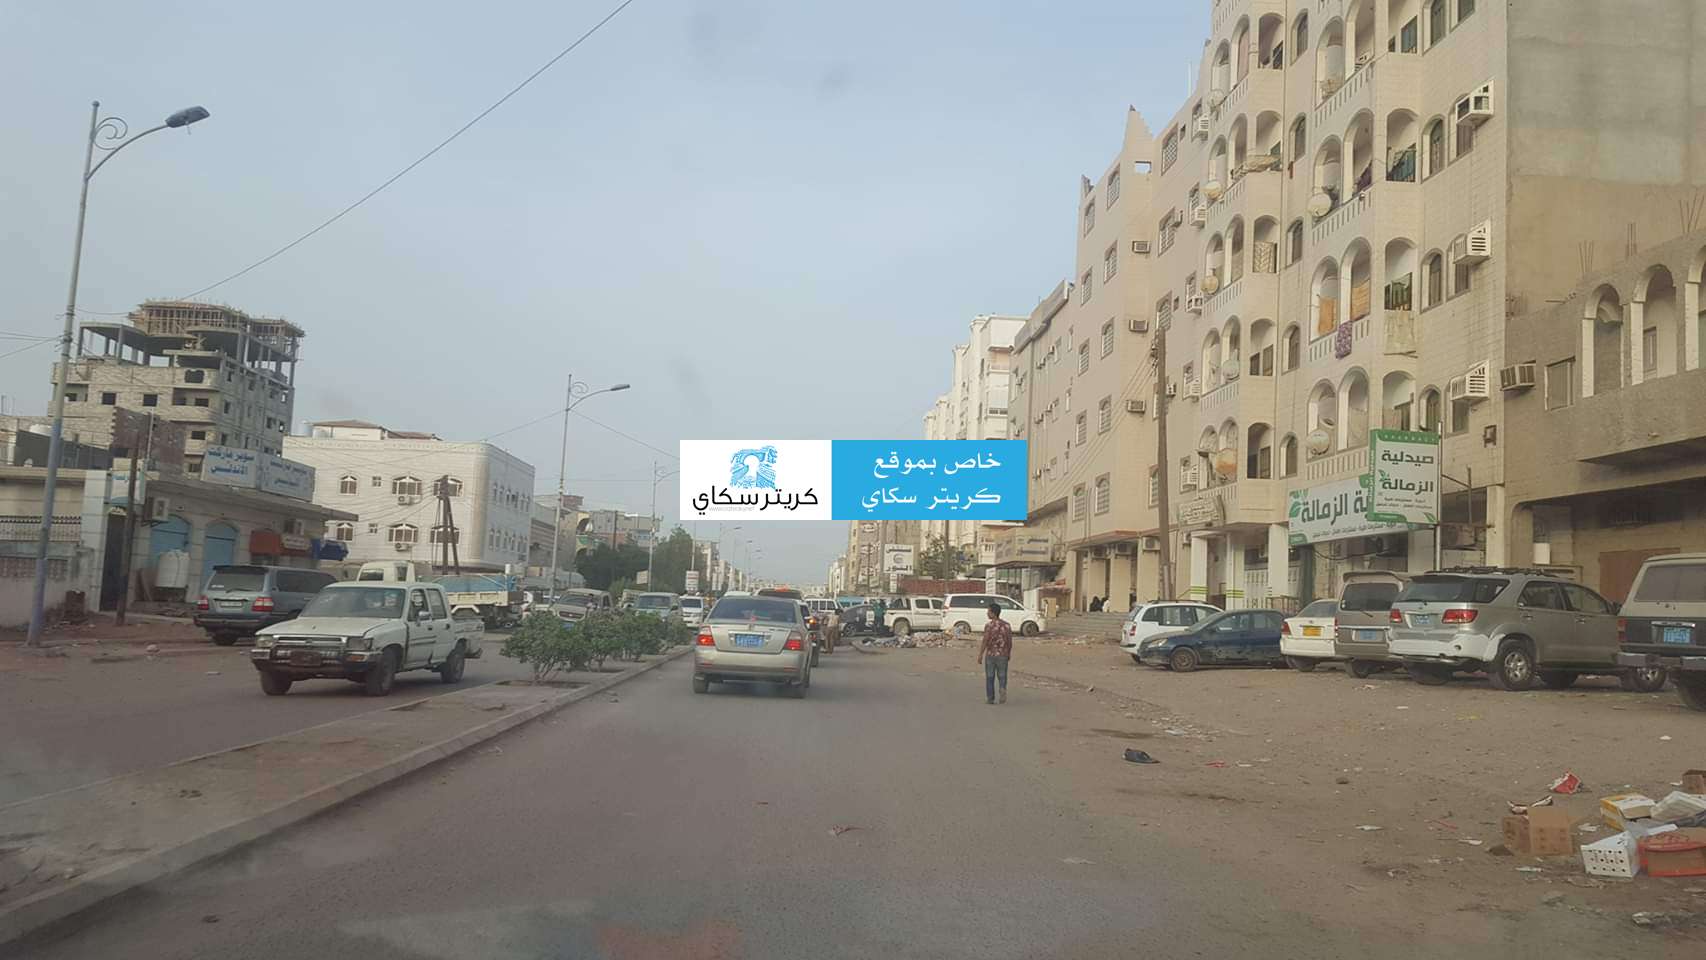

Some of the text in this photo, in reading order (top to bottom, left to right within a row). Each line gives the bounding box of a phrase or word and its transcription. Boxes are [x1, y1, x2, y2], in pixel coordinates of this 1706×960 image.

[1381, 450, 1434, 467] صيدلية
[1382, 478, 1434, 496] الزمالة
[1301, 492, 1348, 526] الزمالة
